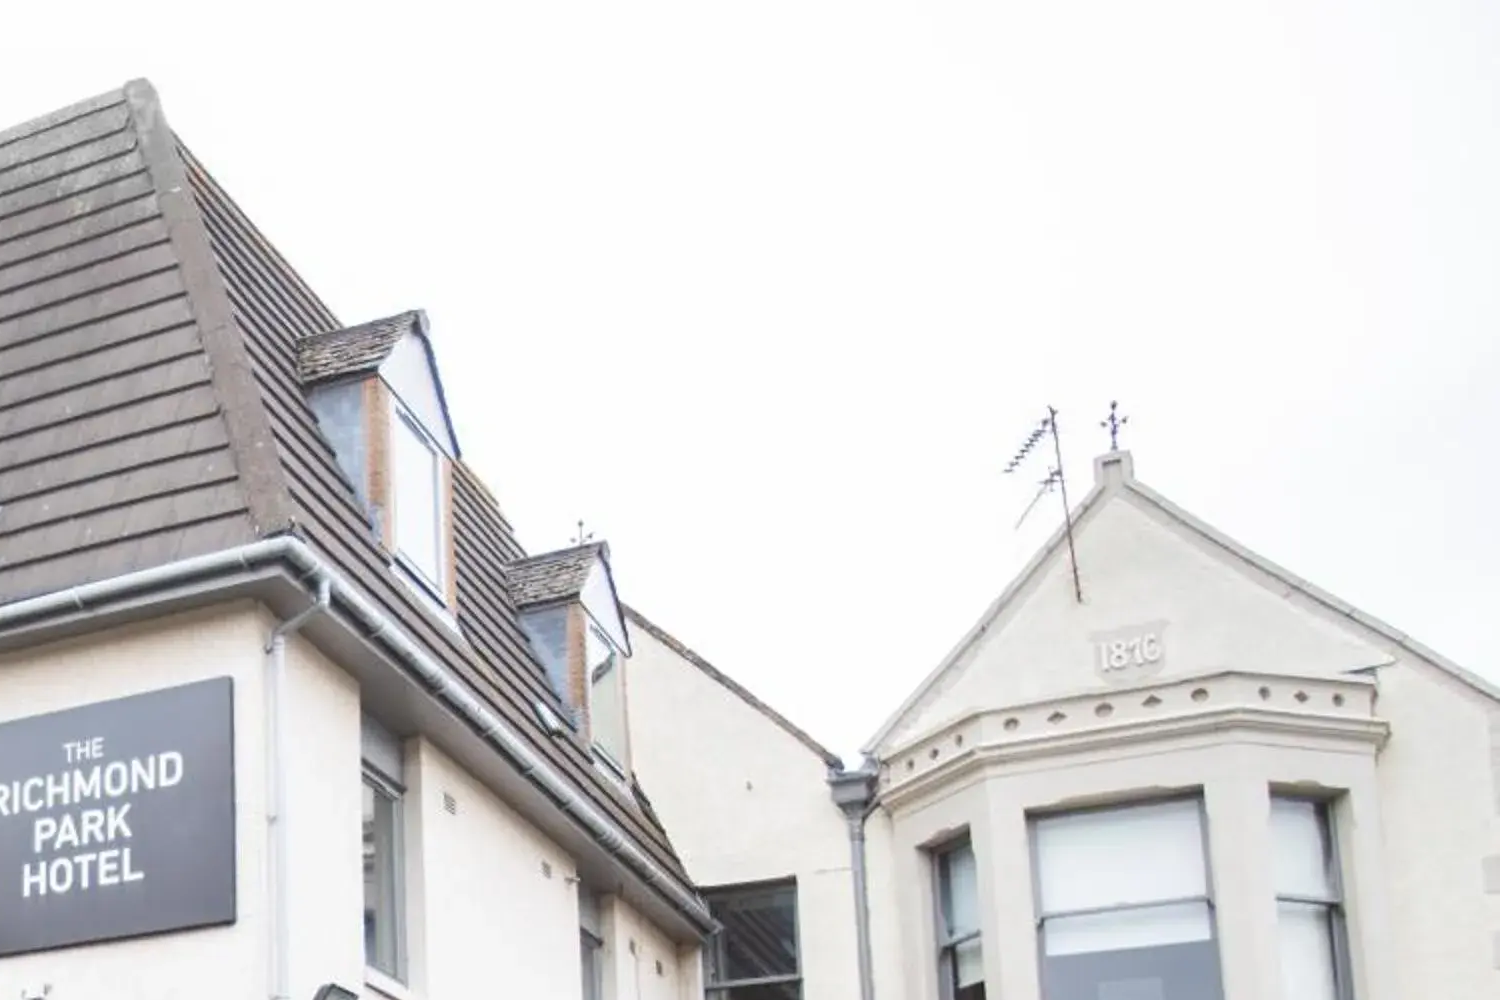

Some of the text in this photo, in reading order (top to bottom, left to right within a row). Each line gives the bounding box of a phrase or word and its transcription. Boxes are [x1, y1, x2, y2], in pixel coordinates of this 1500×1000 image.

[63, 737, 104, 763] THE
[34, 803, 132, 853] PARK
[22, 848, 145, 898] HOTEL
